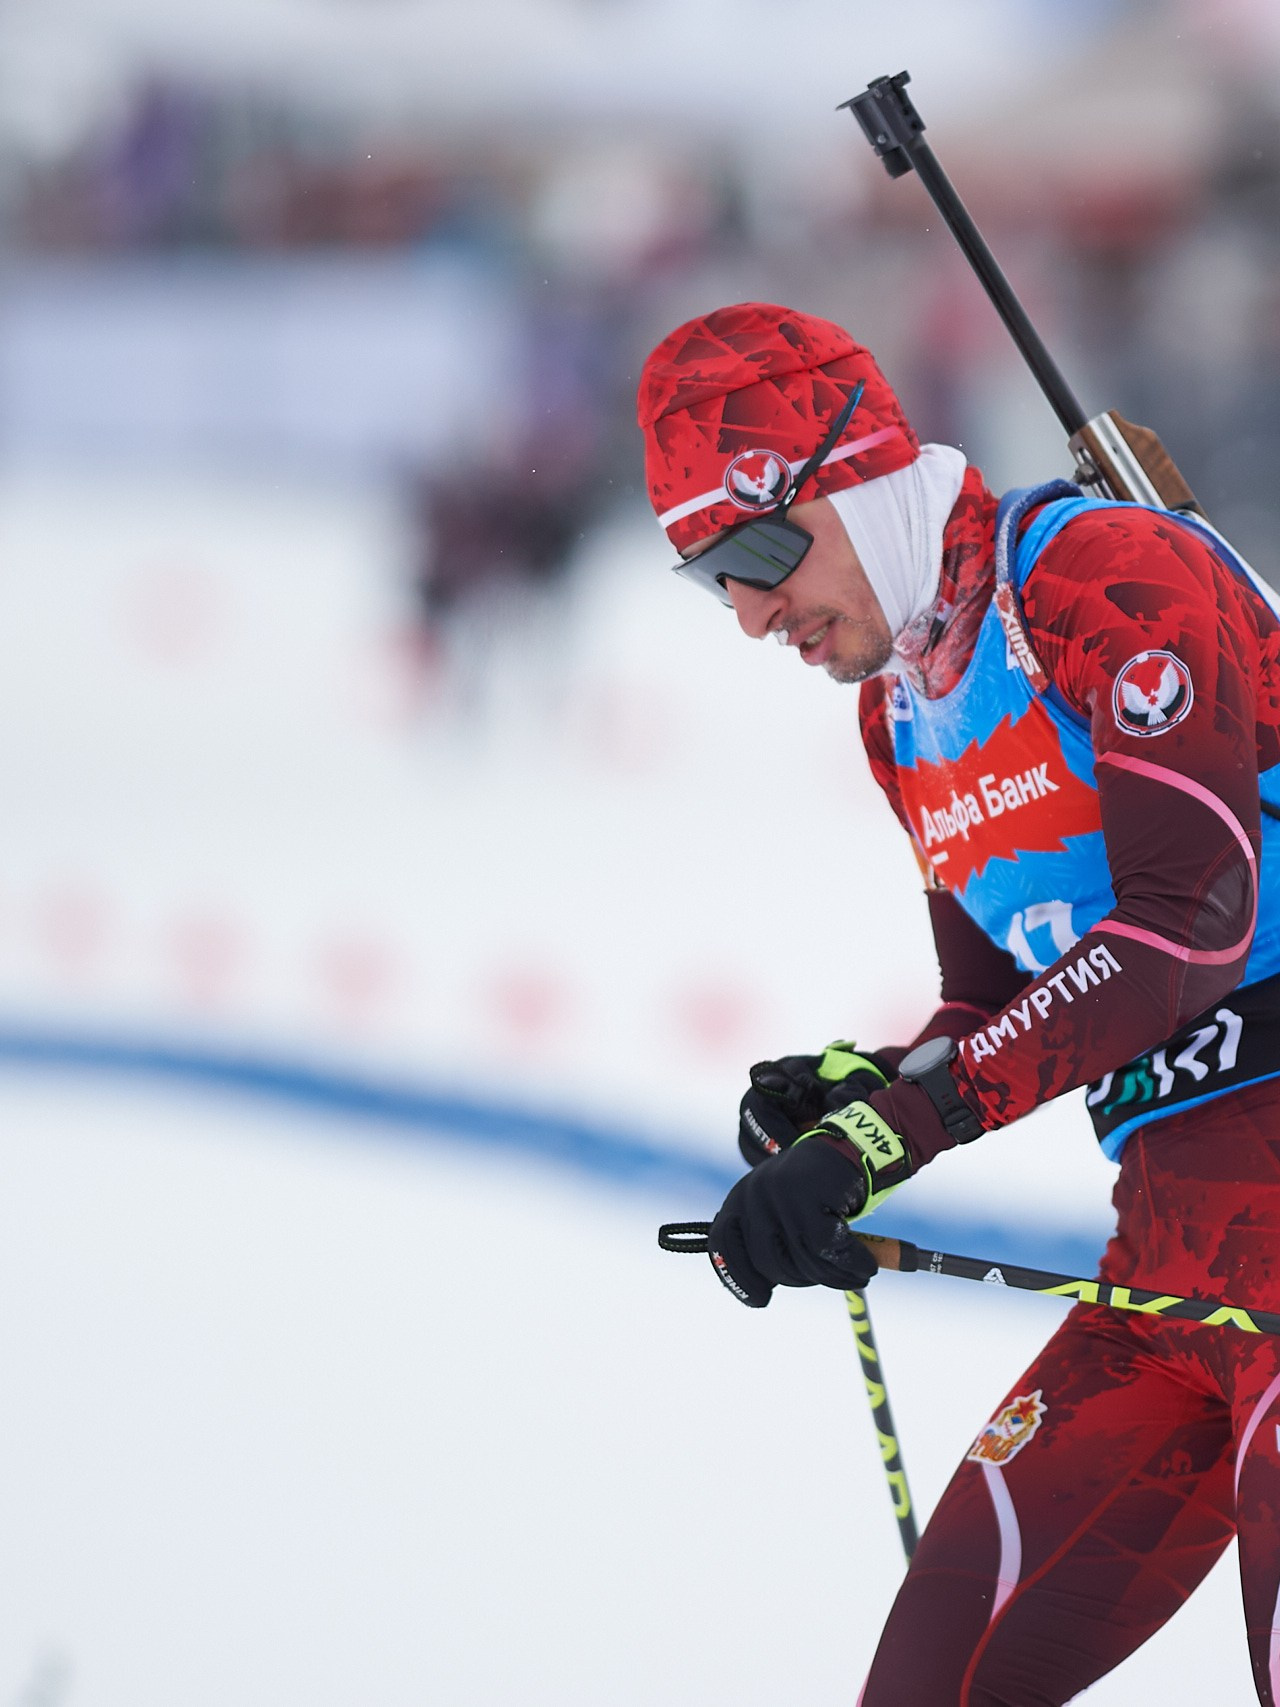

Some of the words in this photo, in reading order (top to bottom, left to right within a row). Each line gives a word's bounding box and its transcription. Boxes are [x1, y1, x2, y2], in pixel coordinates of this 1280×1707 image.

[920, 790, 984, 848] Альфа
[978, 762, 1060, 818] Банк
[958, 943, 1123, 1063] ДМУРТИЯ
